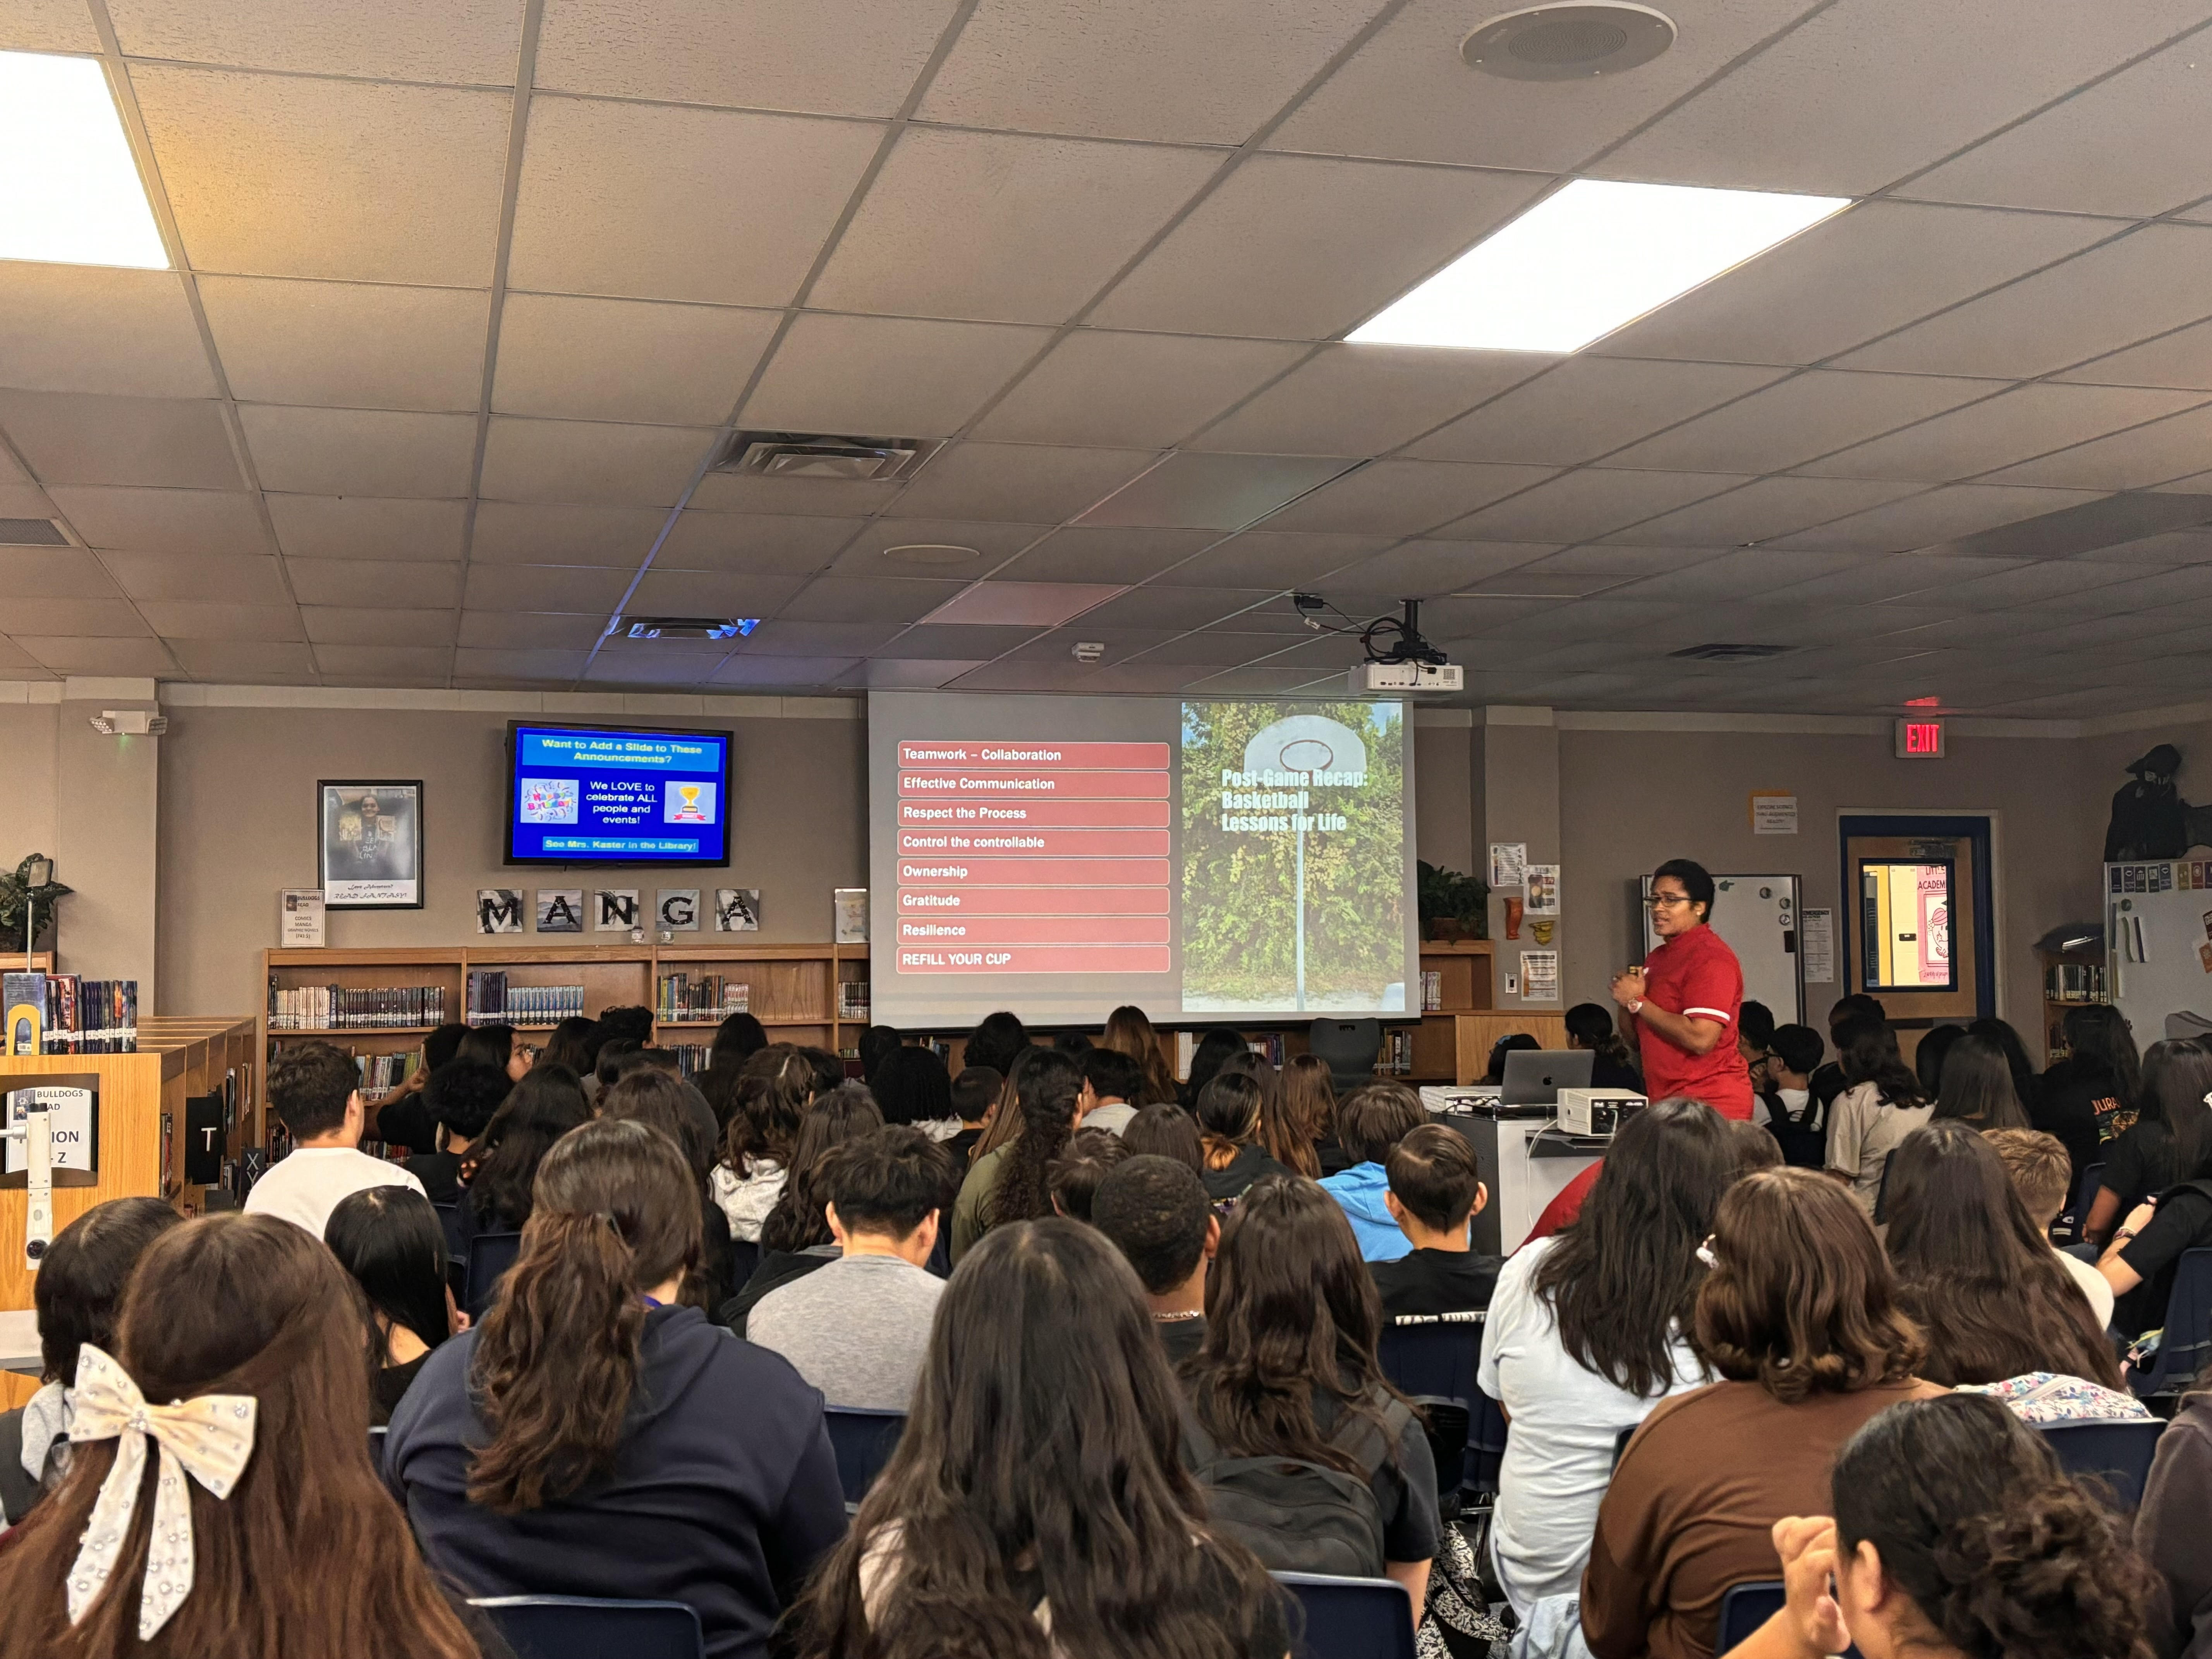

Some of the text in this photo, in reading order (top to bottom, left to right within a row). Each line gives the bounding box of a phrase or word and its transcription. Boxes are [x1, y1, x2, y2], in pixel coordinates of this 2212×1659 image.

[1907, 724, 1939, 752] EXIT
[542, 739, 572, 748] Want
[575, 741, 586, 749] to
[589, 741, 612, 750] Add
[625, 743, 653, 751] Slide
[670, 745, 702, 754] These
[574, 752, 672, 763] Announcements?
[903, 748, 967, 760] Teamwork
[981, 749, 1061, 761] Collaboration
[903, 777, 1055, 789] Effective Communication
[1222, 768, 1368, 788] Post-Game Recap:
[590, 781, 608, 790] We
[611, 782, 642, 791] LOVE
[586, 793, 658, 802] celebrate ALL
[1222, 791, 1309, 809] Basketball
[593, 804, 628, 814] people
[903, 807, 1027, 820] Respect the Process
[603, 816, 640, 824] events!
[1222, 813, 1346, 831] Lessons for Life
[659, 842, 696, 851] Library!
[903, 836, 1045, 848] Control the controllable
[903, 866, 968, 879] Ownership
[903, 895, 960, 906] Gratitude
[903, 924, 966, 936] Resilience
[903, 953, 1011, 965] REFILL YOUR CUP
[201, 1127, 217, 1151] T
[247, 1153, 259, 1170] X
